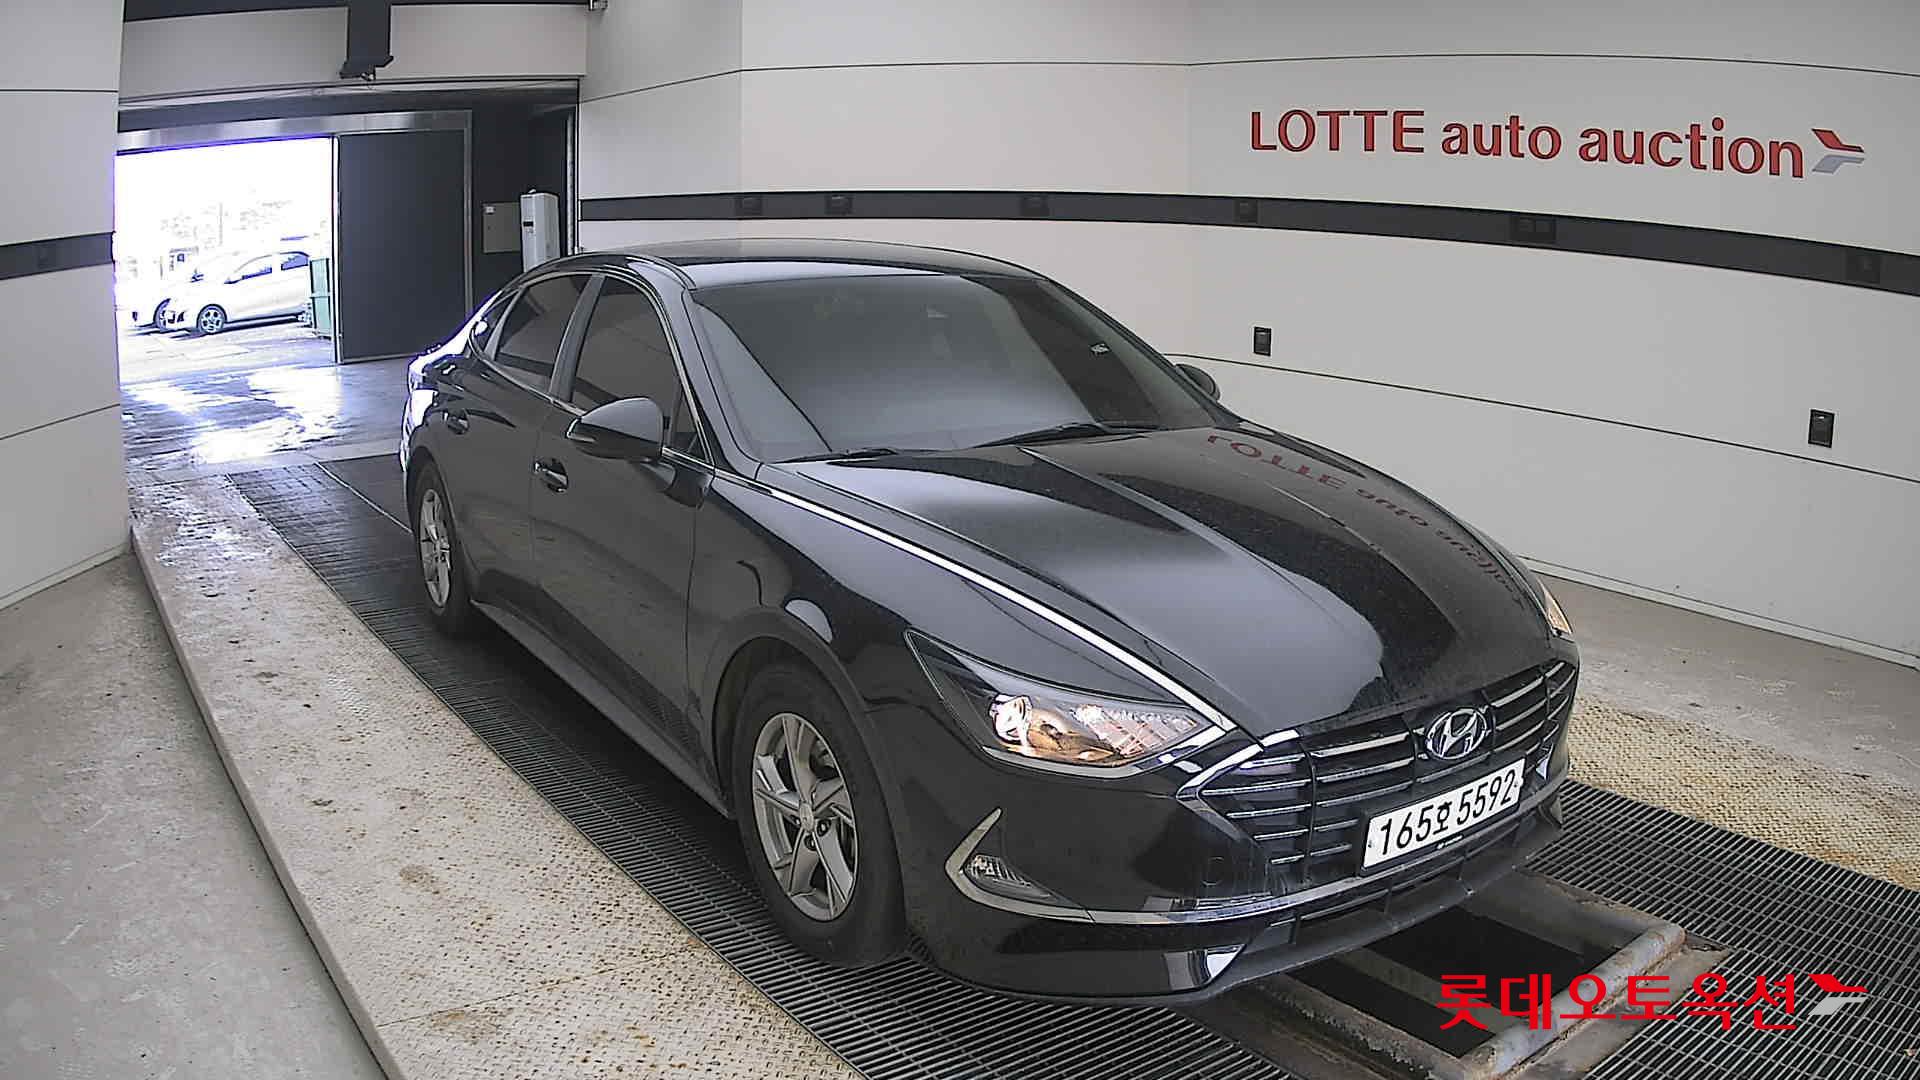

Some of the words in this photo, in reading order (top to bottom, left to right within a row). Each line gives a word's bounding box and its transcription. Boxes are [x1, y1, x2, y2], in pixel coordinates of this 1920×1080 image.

[1251, 110, 1425, 152] LOTTE
[1441, 115, 1562, 159] auto
[1577, 117, 1804, 179] auction
[1380, 801, 1453, 856] 165호
[1456, 768, 1516, 826] 5592
